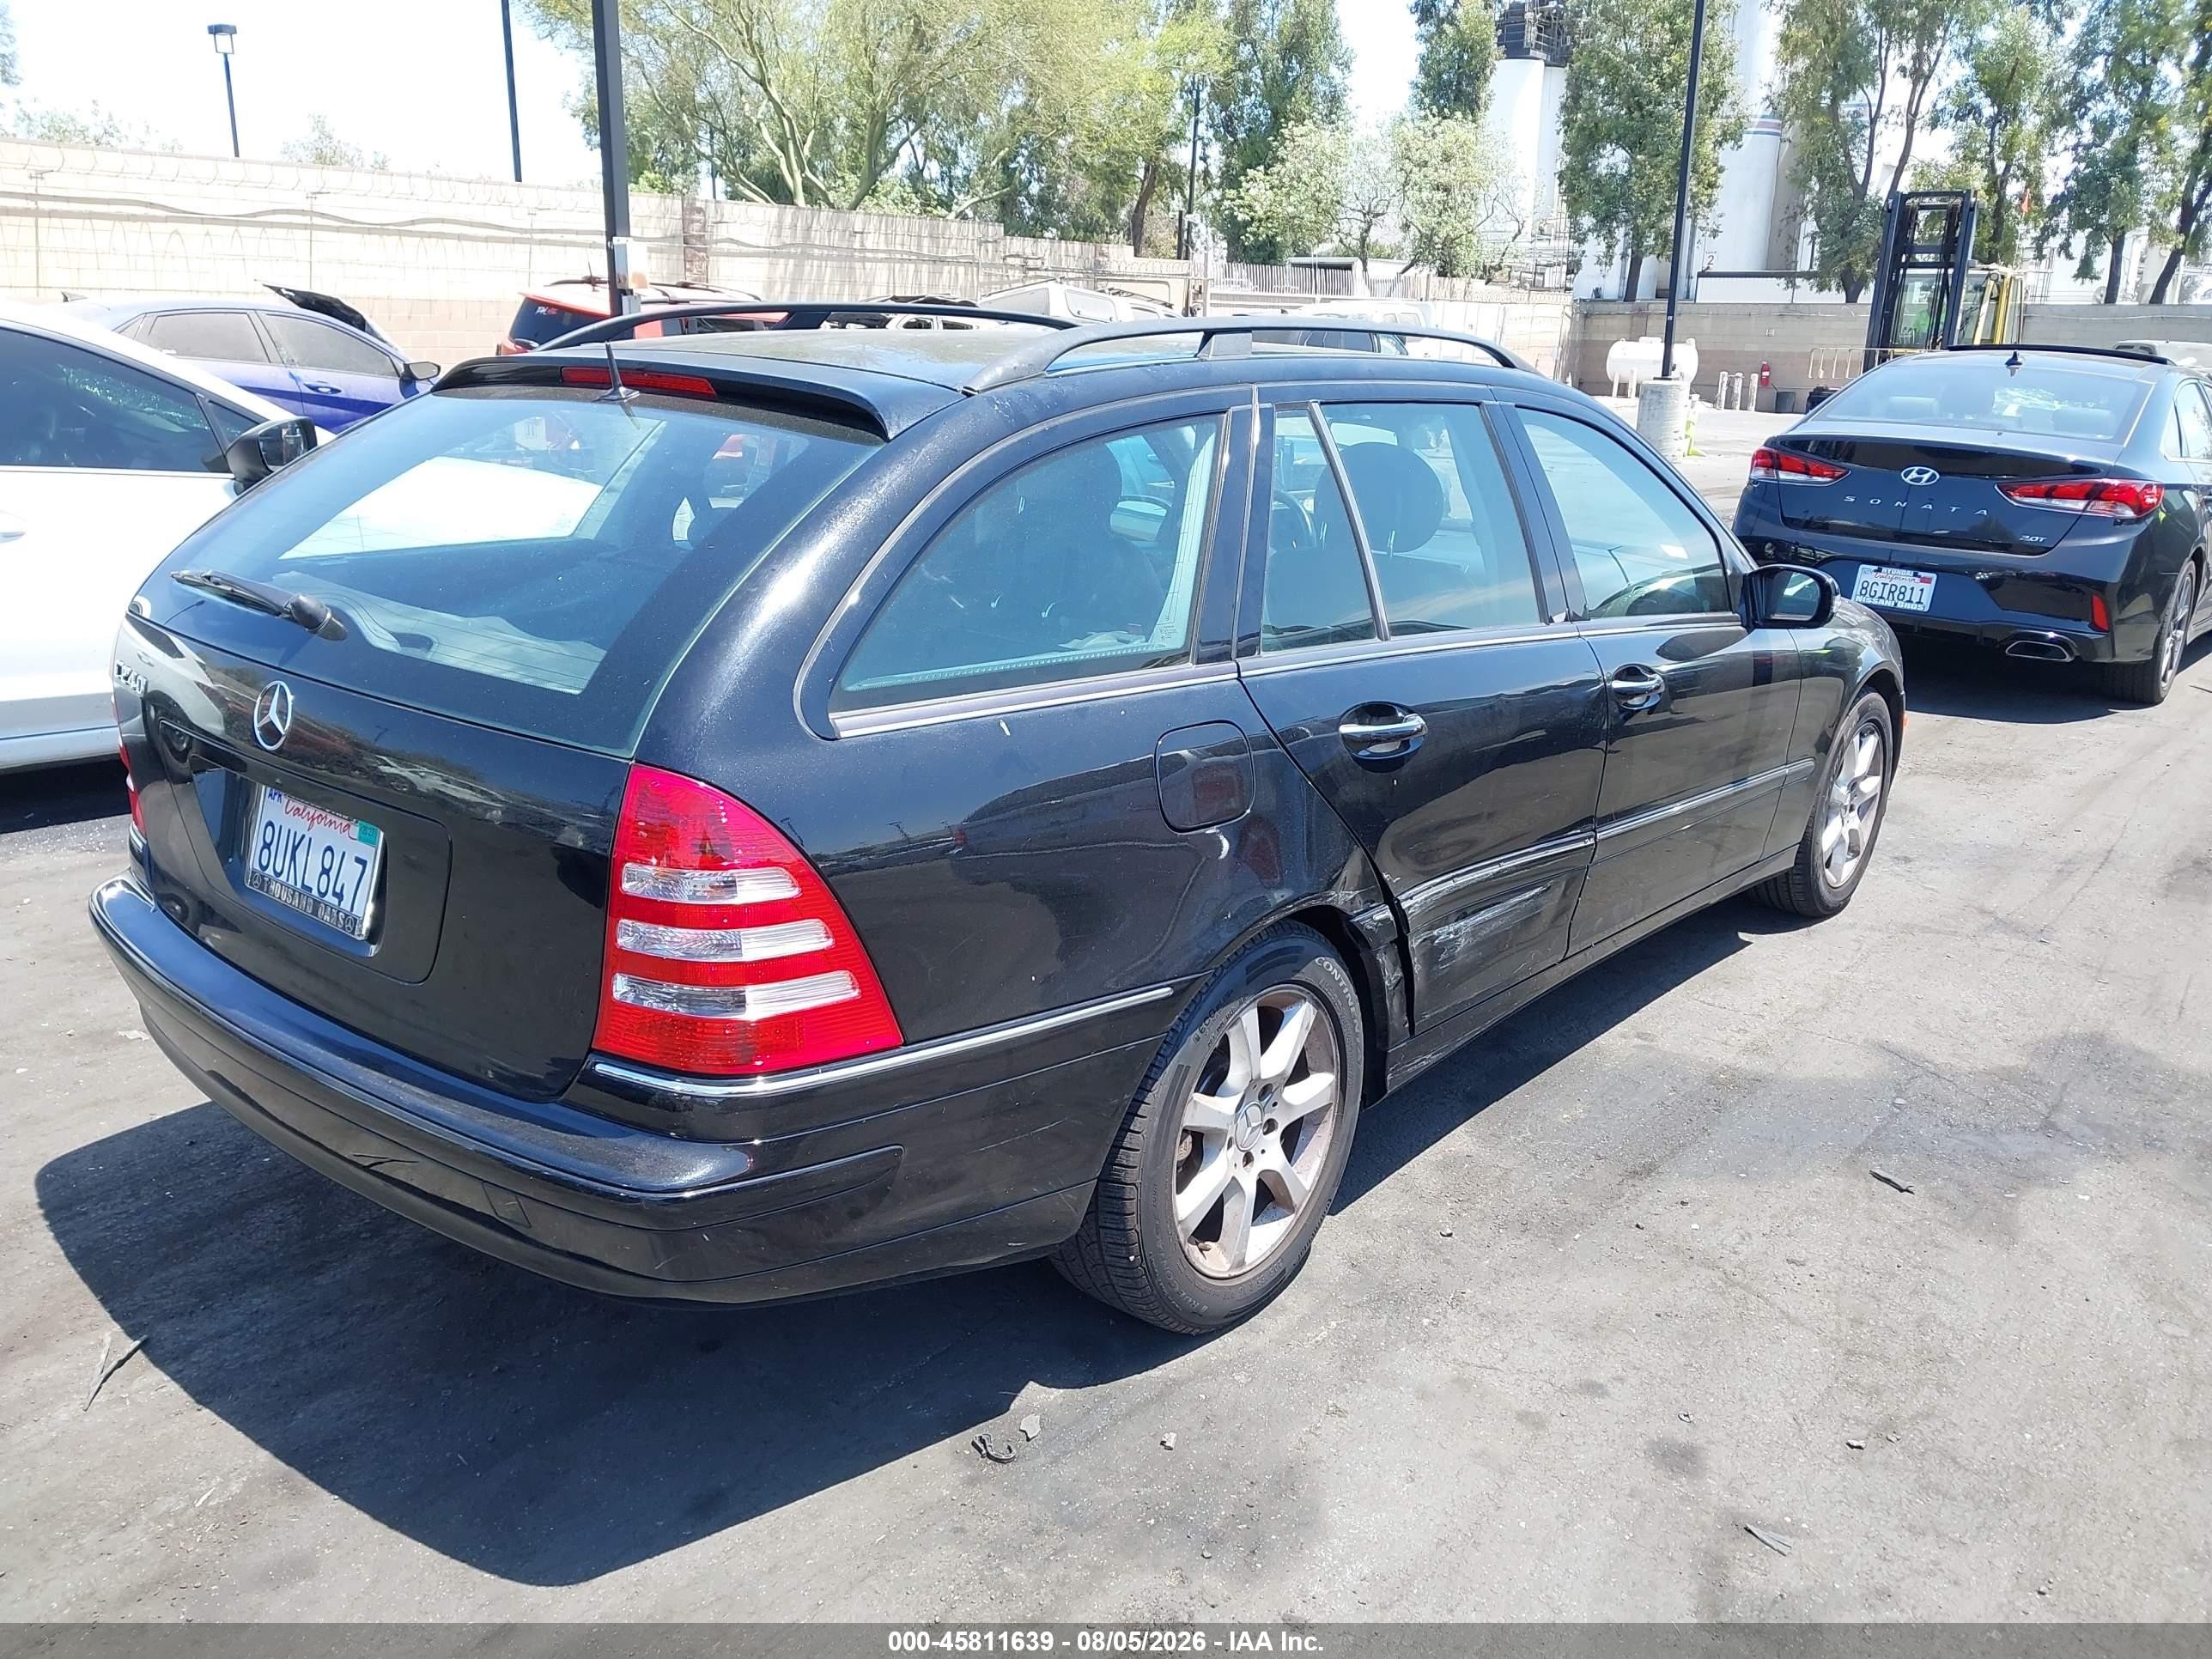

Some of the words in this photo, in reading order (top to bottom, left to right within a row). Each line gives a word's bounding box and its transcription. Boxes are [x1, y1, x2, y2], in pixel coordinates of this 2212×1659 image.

[1843, 495, 1989, 516] SONATA
[2019, 535, 2047, 544] 2.0T
[1859, 580, 1924, 605] 8GIR811
[284, 798, 358, 841] California
[258, 820, 368, 913] 8UKL847
[262, 877, 313, 915] THOUSAND
[318, 903, 345, 928] OAKS
